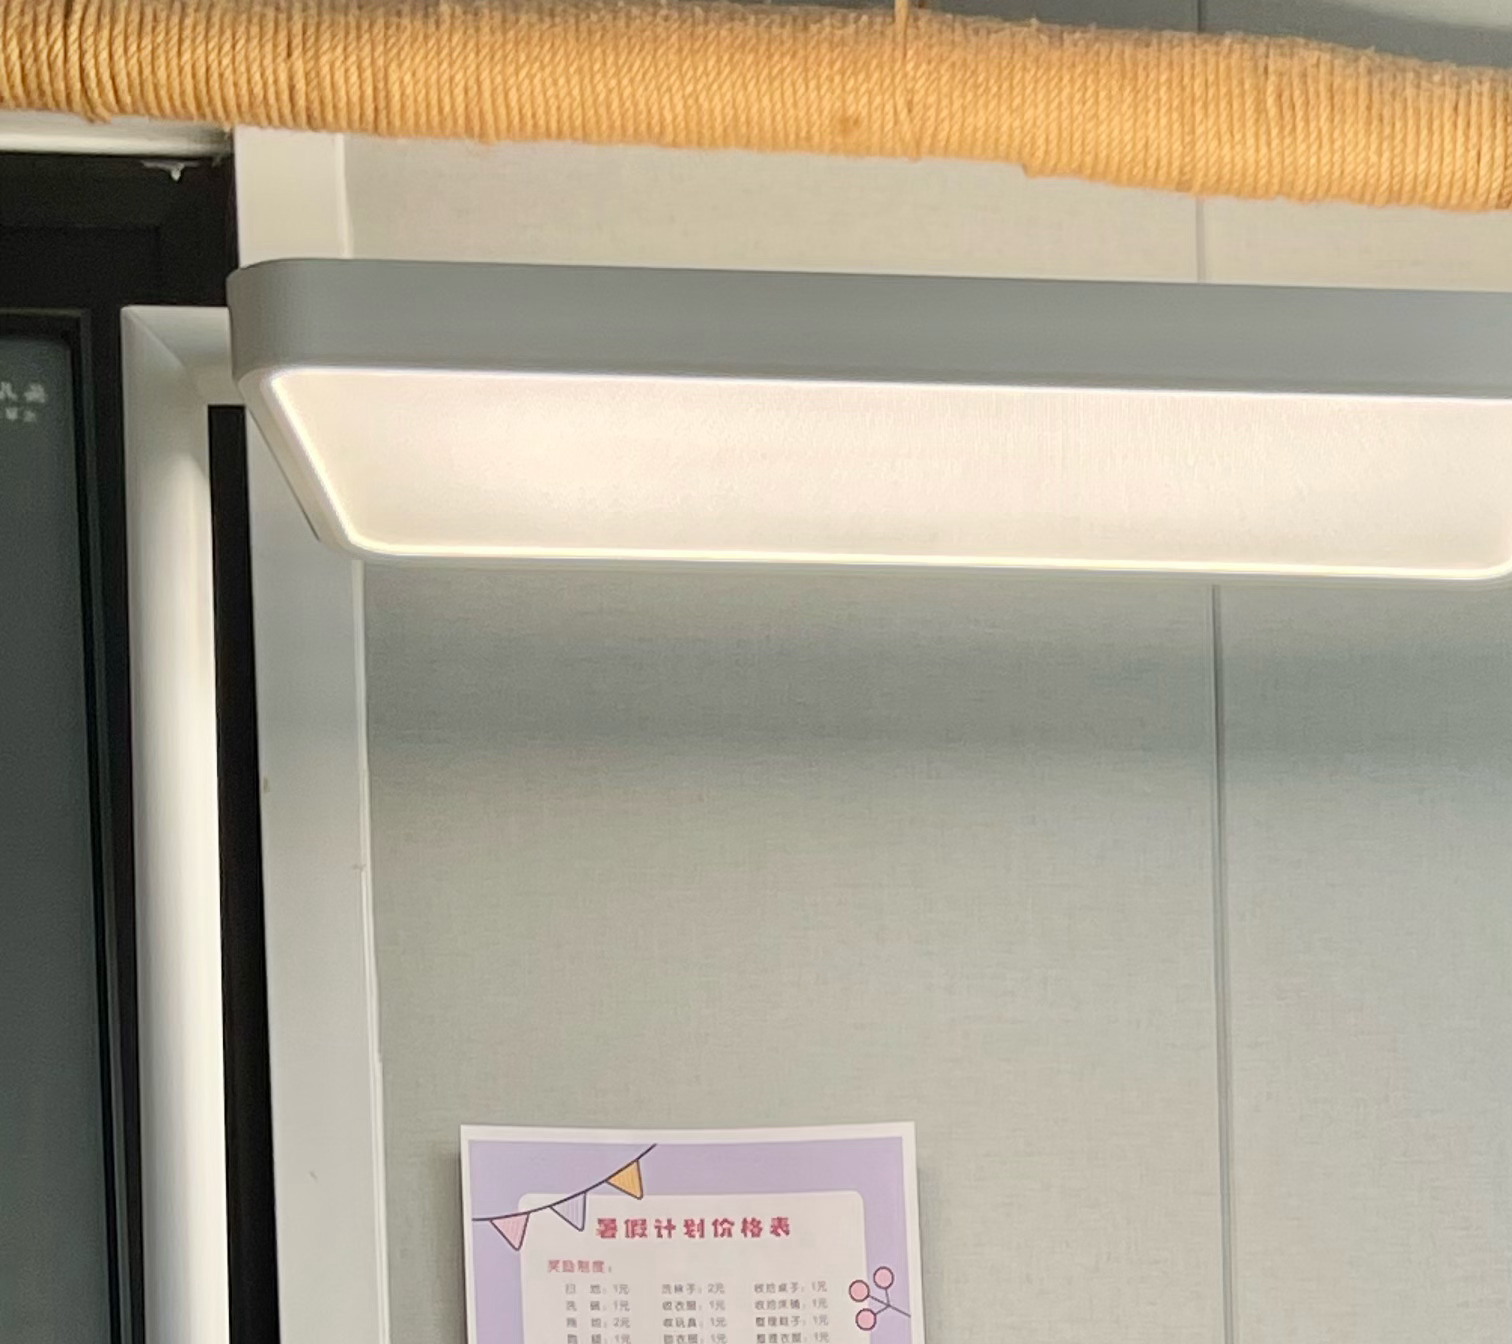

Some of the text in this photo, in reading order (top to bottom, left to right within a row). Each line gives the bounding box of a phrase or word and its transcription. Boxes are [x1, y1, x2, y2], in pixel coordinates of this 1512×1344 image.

[595, 1216, 792, 1240] 暑假计划价格表
